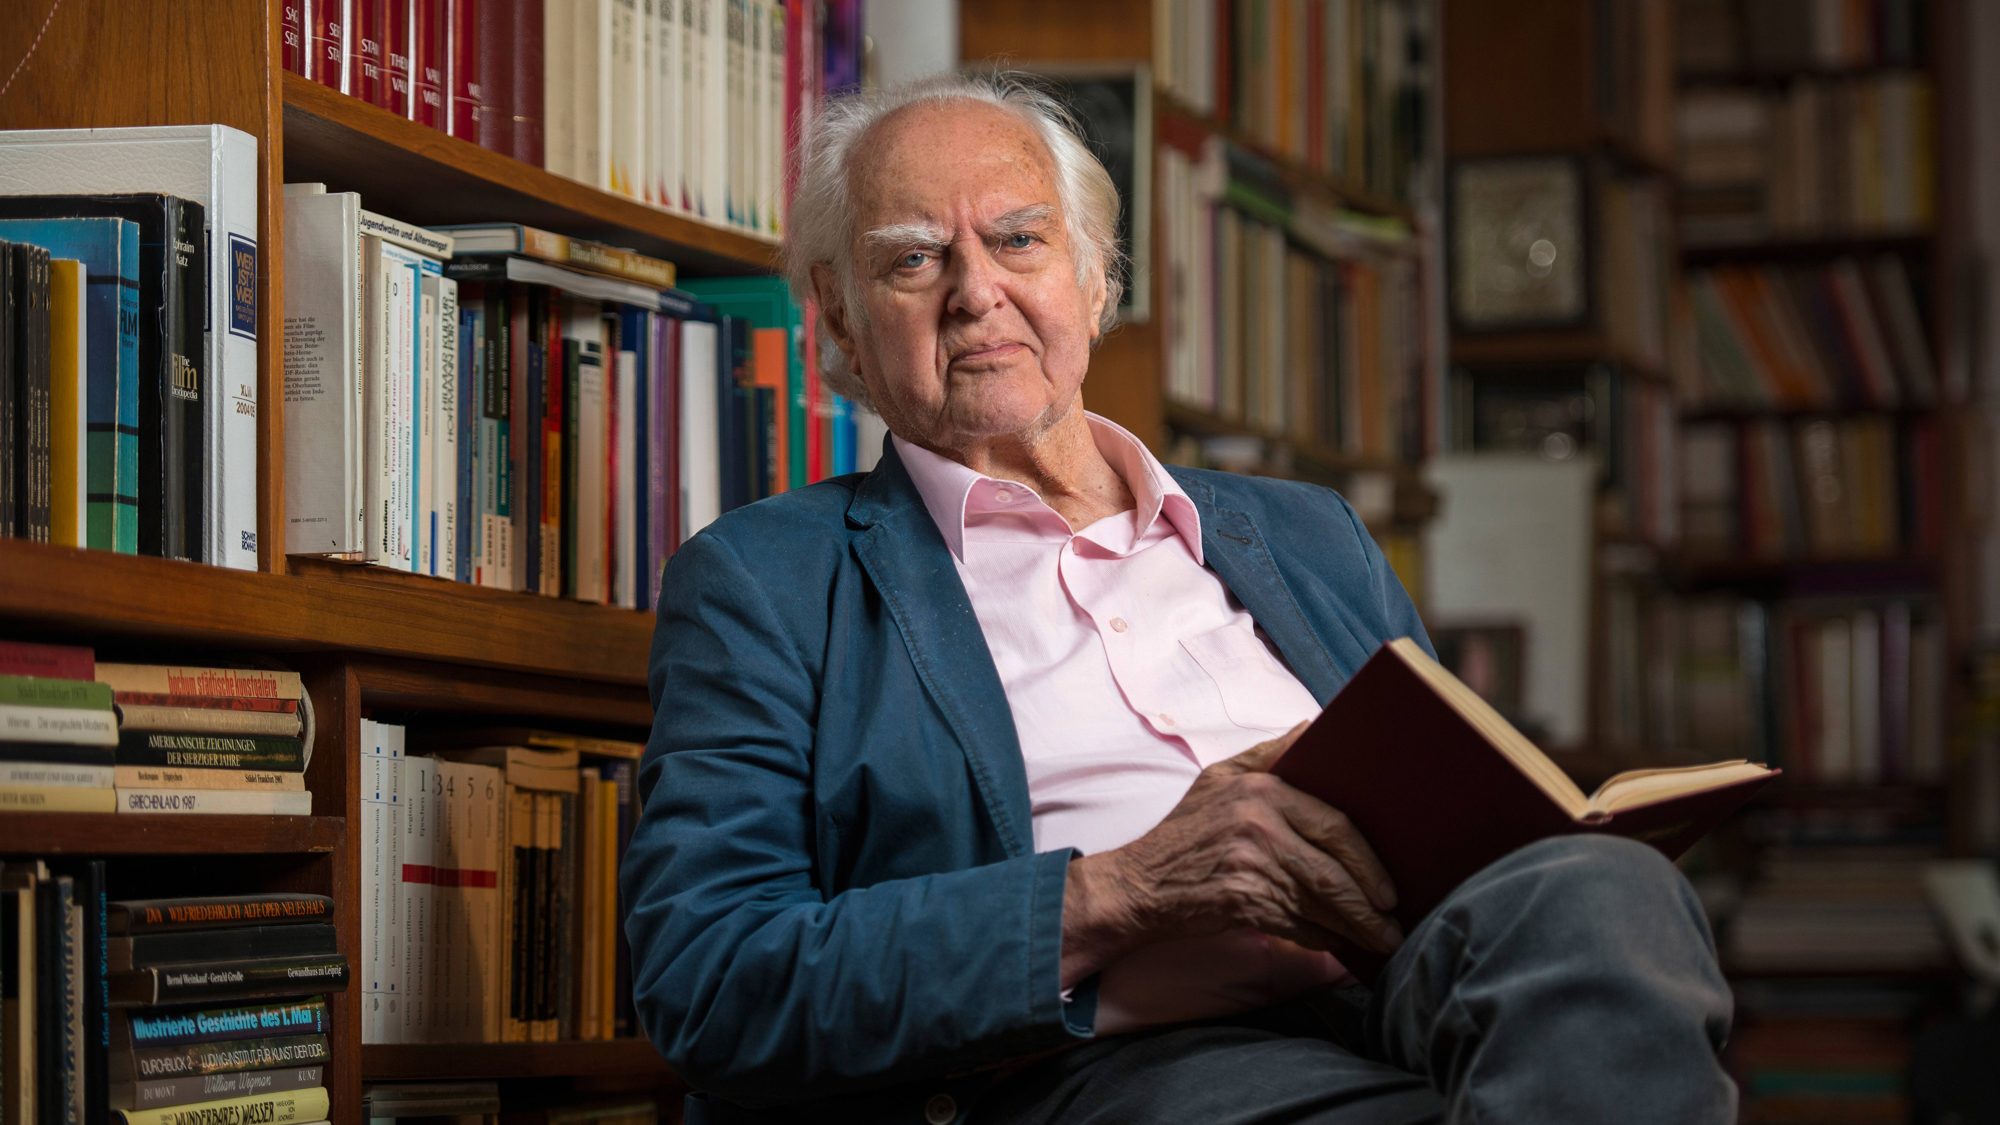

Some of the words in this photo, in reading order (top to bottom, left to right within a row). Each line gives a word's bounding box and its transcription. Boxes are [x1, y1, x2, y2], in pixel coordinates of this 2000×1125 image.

[361, 215, 400, 237] Jugendwahn
[401, 230, 413, 241] und
[413, 231, 447, 252] Altersangst
[173, 237, 195, 254] Ephraim
[176, 253, 188, 267] Katz
[235, 250, 254, 272] WER
[237, 268, 255, 290] IST?
[235, 284, 254, 305] WER
[120, 308, 138, 337] FILM
[172, 352, 197, 390] Film
[181, 356, 190, 366] The
[167, 667, 196, 696] bochum
[197, 669, 234, 697] städtische
[233, 669, 278, 699] kunstgalerie
[148, 735, 206, 750] AMERIKANISCHE
[206, 738, 256, 752] ZEICHNUNGEN
[167, 751, 182, 765] DER
[183, 752, 219, 766] SIEBZIGER
[219, 754, 241, 767] JAHRE
[137, 770, 159, 781] Beckmann
[244, 773, 258, 783] Städel
[258, 774, 274, 784] Frankfurt
[420, 770, 426, 792] 1
[435, 774, 443, 796] 3
[446, 776, 454, 797] 4
[467, 777, 475, 798] 5
[485, 778, 495, 801] 6
[129, 794, 180, 810] GRIECHENLAND
[181, 796, 196, 810] 1987
[168, 905, 208, 922] WILFRIED
[208, 904, 241, 920] EHRLICH
[243, 903, 261, 918] ALTE
[305, 899, 325, 915] HAUS
[98, 892, 107, 976] Wirklichkeit
[166, 973, 182, 987] Bernd
[182, 972, 208, 986] Weinkauf
[210, 971, 228, 984] Gerald
[228, 970, 244, 982] Große
[287, 966, 318, 978] Gewandhaus
[318, 967, 324, 976] zu
[324, 965, 342, 977] Leipzig
[101, 1012, 109, 1046] Ideal
[132, 1014, 195, 1039] Illustrierte
[196, 1007, 258, 1034] Geschichte
[260, 1007, 281, 1028] des
[281, 1006, 291, 1026] 1.
[291, 1003, 313, 1025] Mai
[141, 1057, 187, 1076] DURCHBLICK
[186, 1055, 193, 1070] 2
[256, 1047, 273, 1063] FÜR
[272, 1045, 294, 1062] KUNST
[293, 1044, 308, 1060] DER
[144, 1085, 177, 1100] DUMONT
[204, 1072, 236, 1094] William
[238, 1072, 272, 1097] Wegman
[297, 1069, 316, 1082] KUNZ
[174, 1105, 241, 1125] WUNDERBARES
[241, 1101, 275, 1124] WASSER
